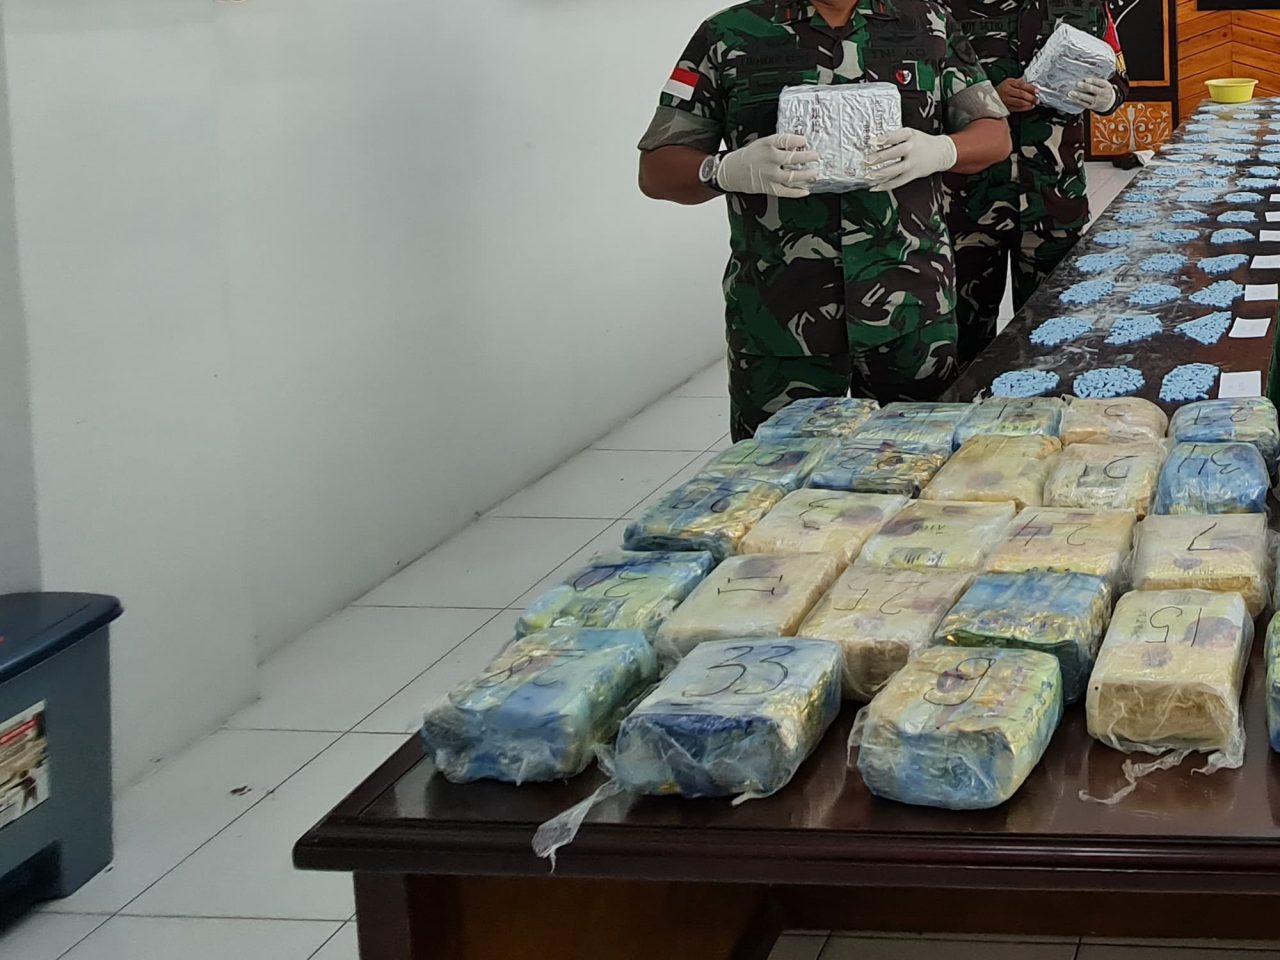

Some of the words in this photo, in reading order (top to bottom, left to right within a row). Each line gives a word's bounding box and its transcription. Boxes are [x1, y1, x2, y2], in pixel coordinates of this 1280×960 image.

[1177, 444, 1241, 475] 34
[1186, 522, 1224, 552] 7
[1145, 606, 1203, 648] 15
[681, 645, 796, 697] 33
